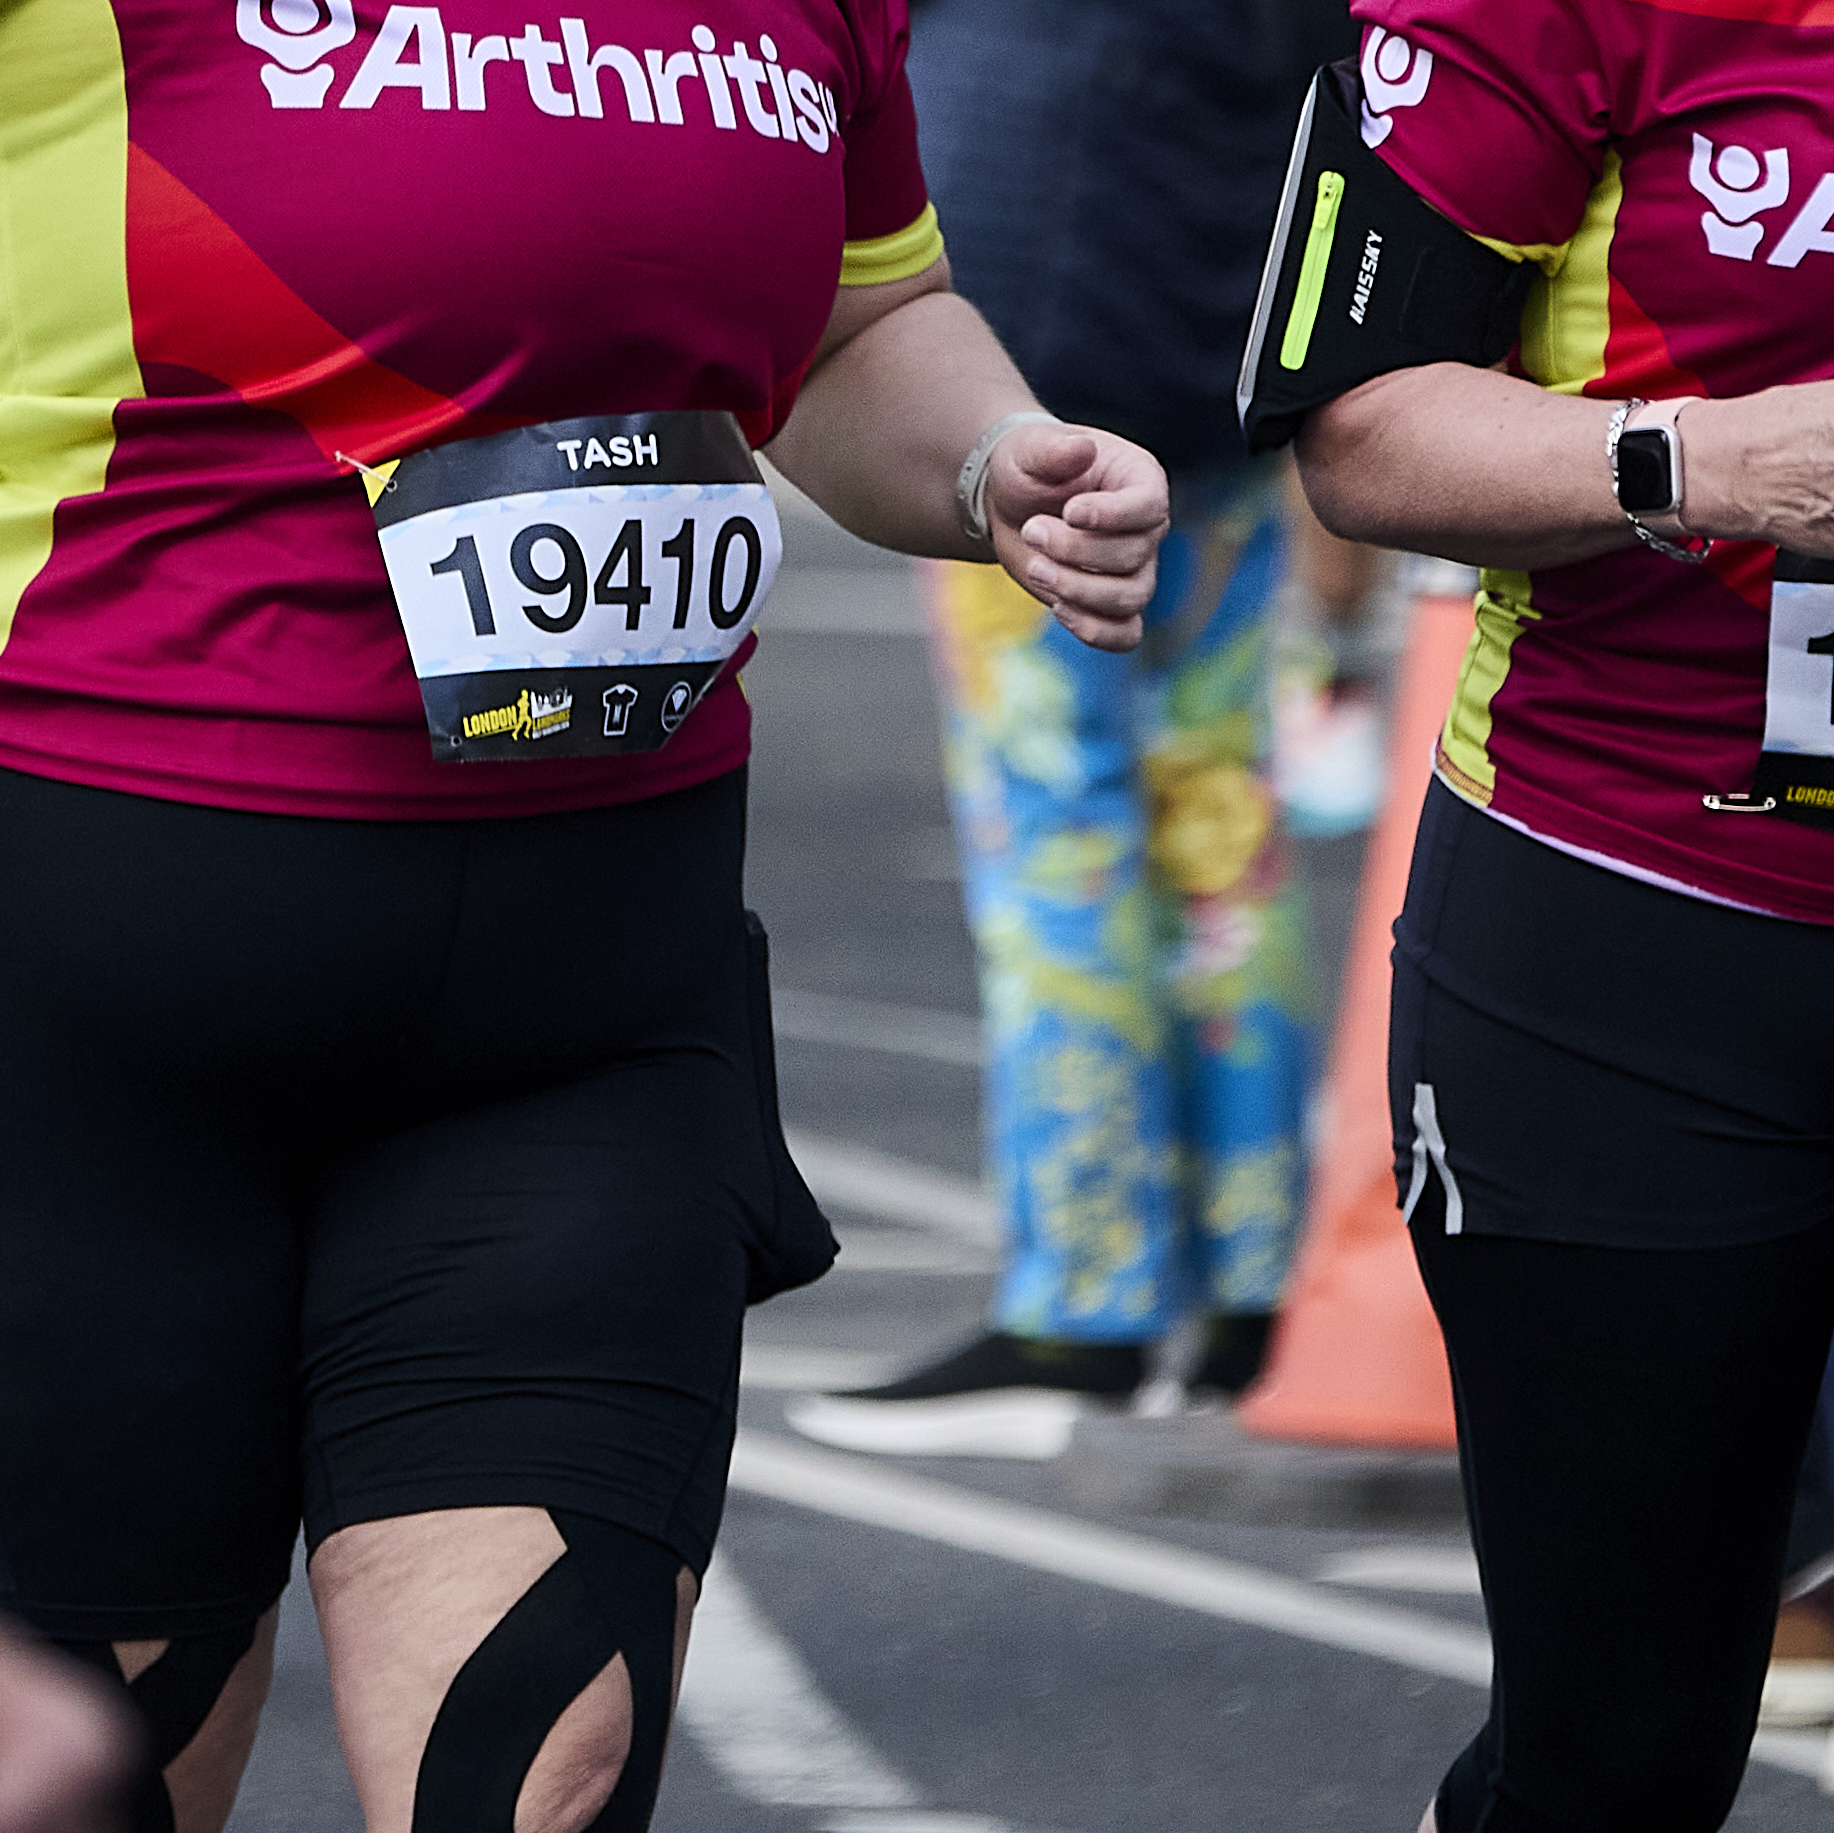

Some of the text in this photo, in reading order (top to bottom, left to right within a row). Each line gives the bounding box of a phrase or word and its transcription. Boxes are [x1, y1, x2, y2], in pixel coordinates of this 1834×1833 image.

[339, 4, 830, 154] Arthritis
[1349, 229, 1383, 325] HAISSKY
[557, 434, 658, 471] TASH
[430, 516, 763, 636] 19410
[462, 704, 517, 738] LONDON
